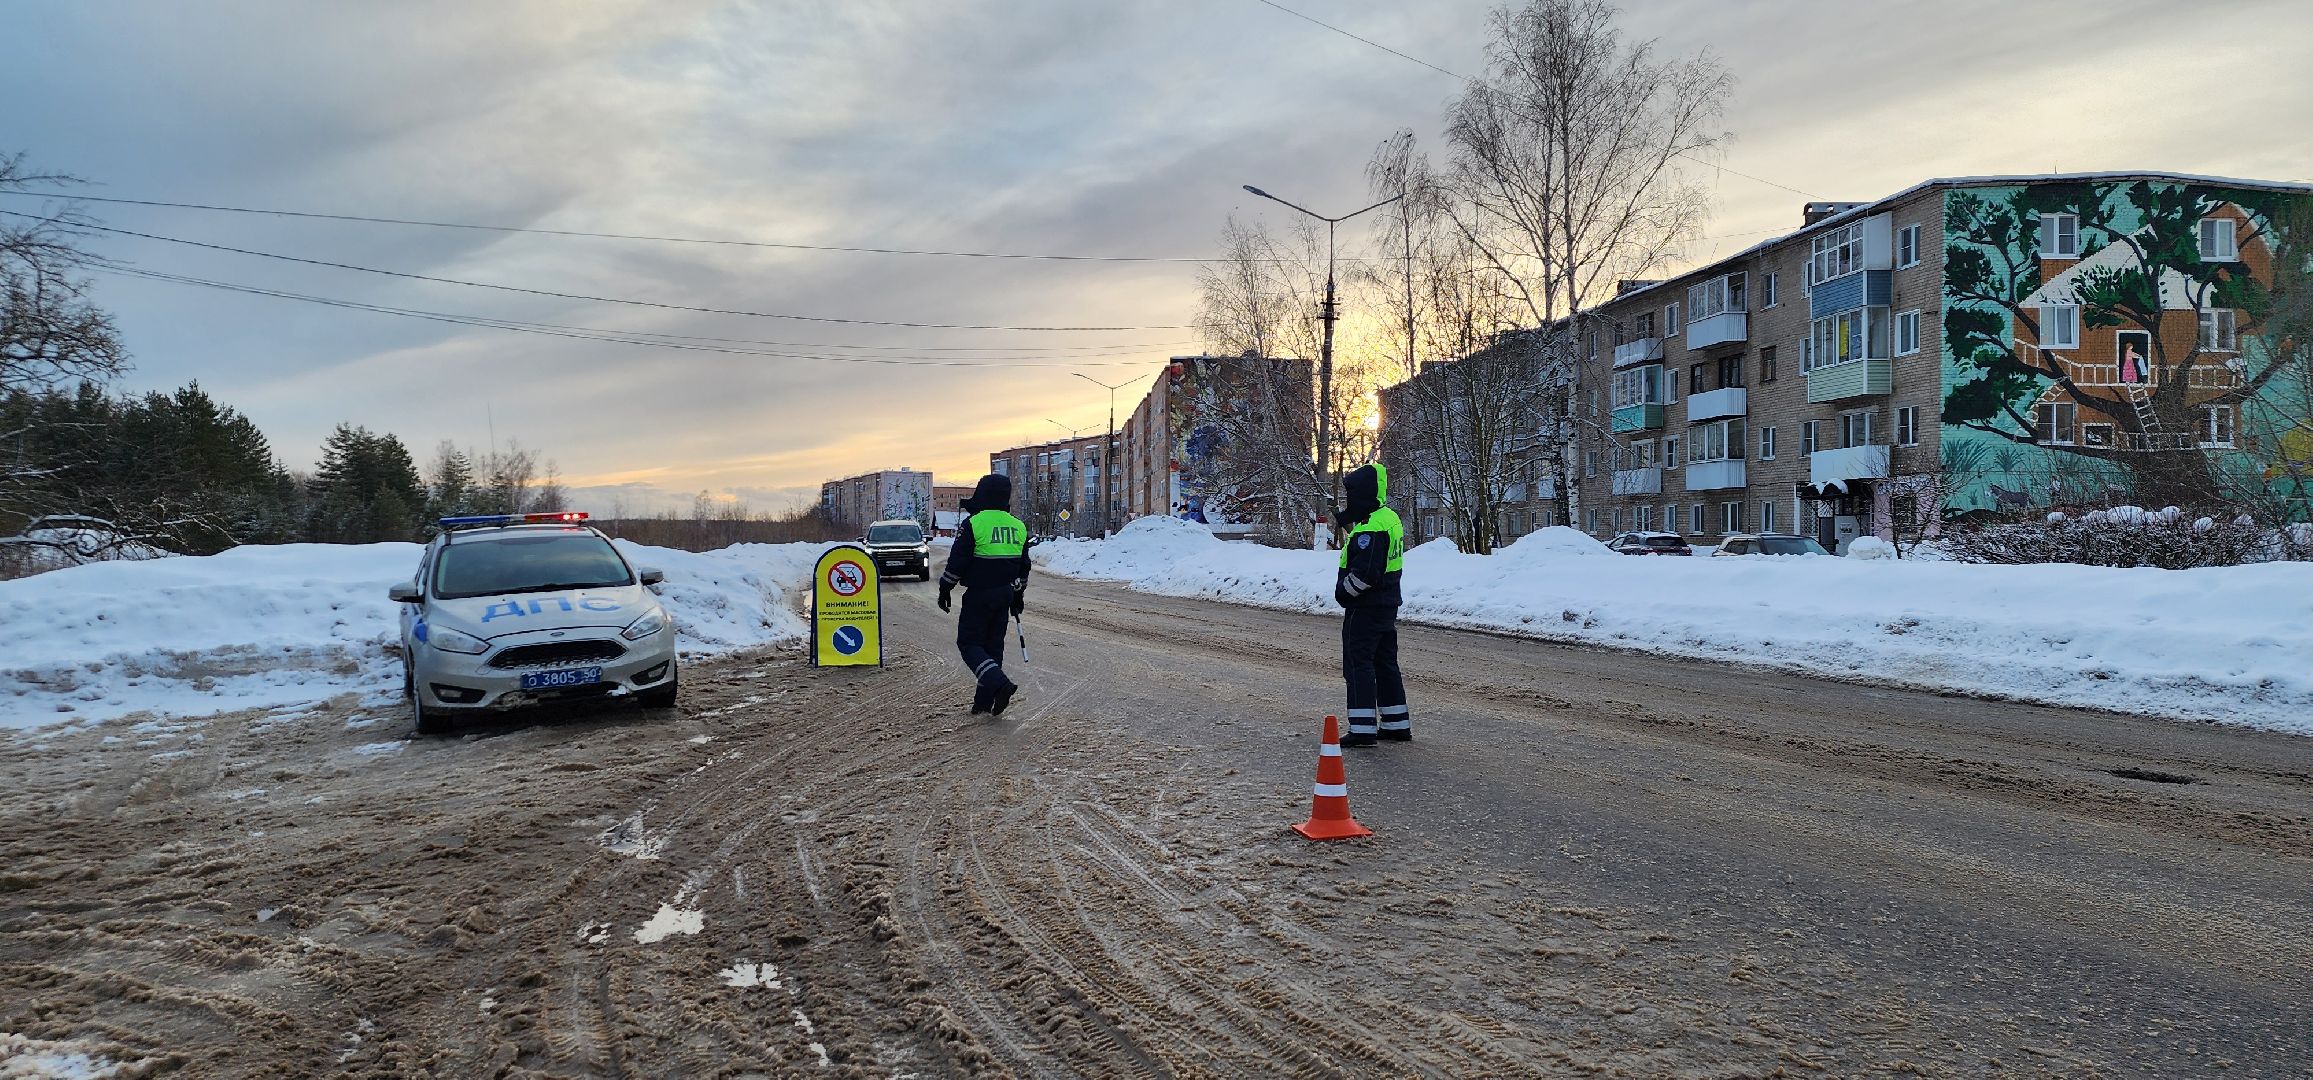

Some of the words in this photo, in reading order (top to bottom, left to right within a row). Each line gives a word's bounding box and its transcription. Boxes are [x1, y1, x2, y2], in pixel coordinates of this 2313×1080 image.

[990, 526, 1020, 545] ДПС
[481, 596, 622, 623] ДПС
[542, 671, 576, 686] 3805
[583, 668, 597, 679] 50
